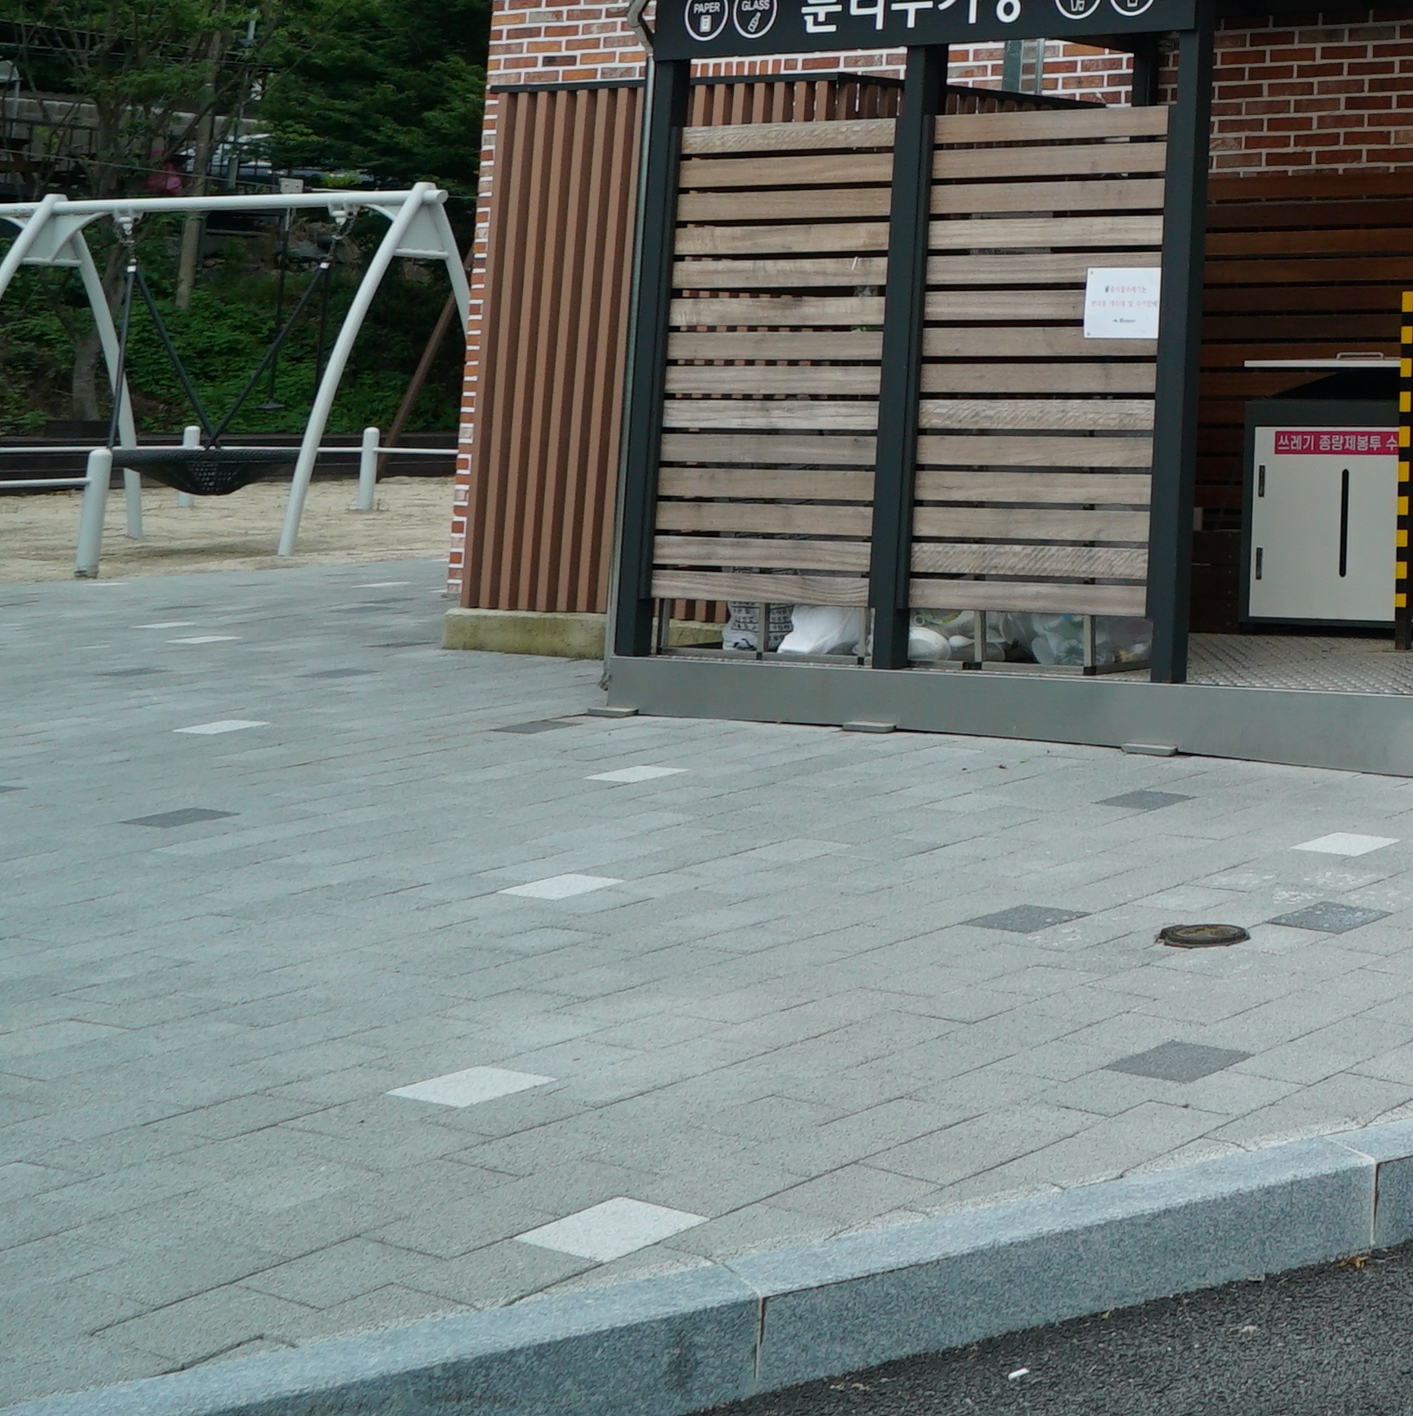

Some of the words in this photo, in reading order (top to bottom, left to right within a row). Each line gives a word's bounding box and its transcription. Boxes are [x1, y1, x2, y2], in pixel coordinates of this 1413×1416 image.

[693, 1, 721, 14] PAPER
[1277, 435, 1315, 451] 쓰레기
[1319, 435, 1382, 451] 종량제봉투
